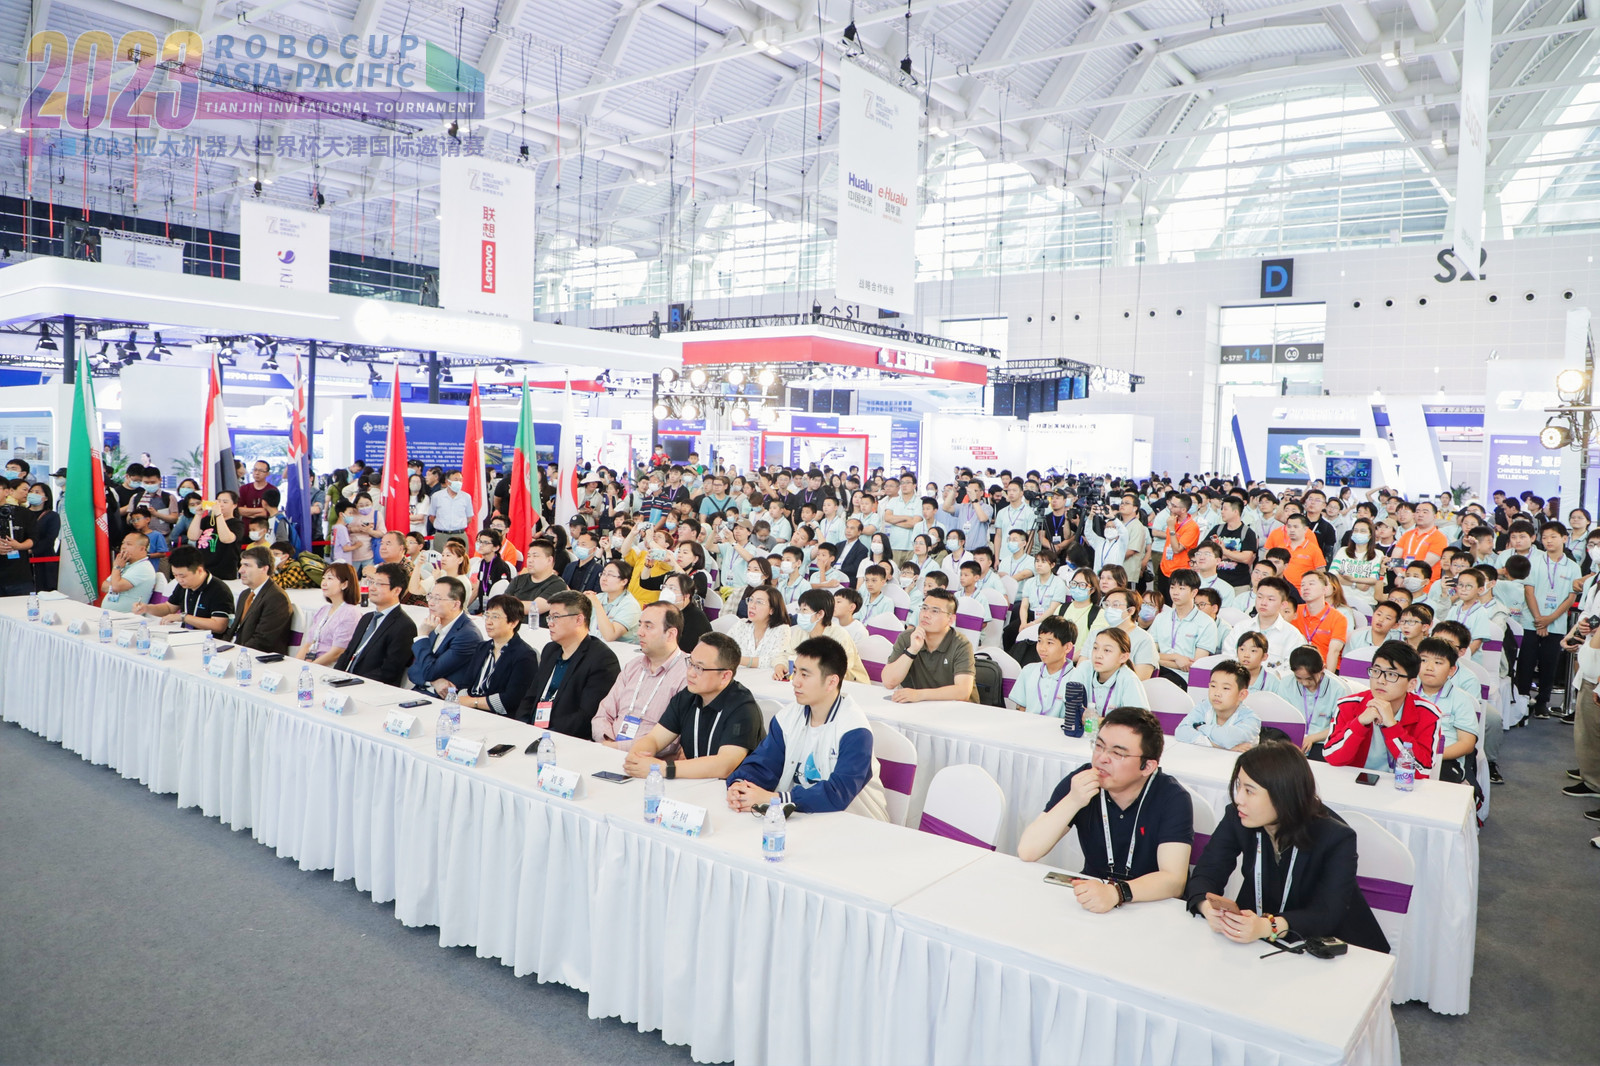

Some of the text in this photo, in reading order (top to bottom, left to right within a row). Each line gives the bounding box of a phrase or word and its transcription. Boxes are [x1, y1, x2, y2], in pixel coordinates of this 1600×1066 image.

[848, 171, 873, 193] Hualu
[482, 206, 496, 239] 联想
[483, 245, 493, 290] Lenovo
[858, 278, 894, 296] 战略合作伙伴
[1265, 265, 1289, 293] D
[846, 305, 861, 320] S1
[1244, 348, 1261, 361] 14
